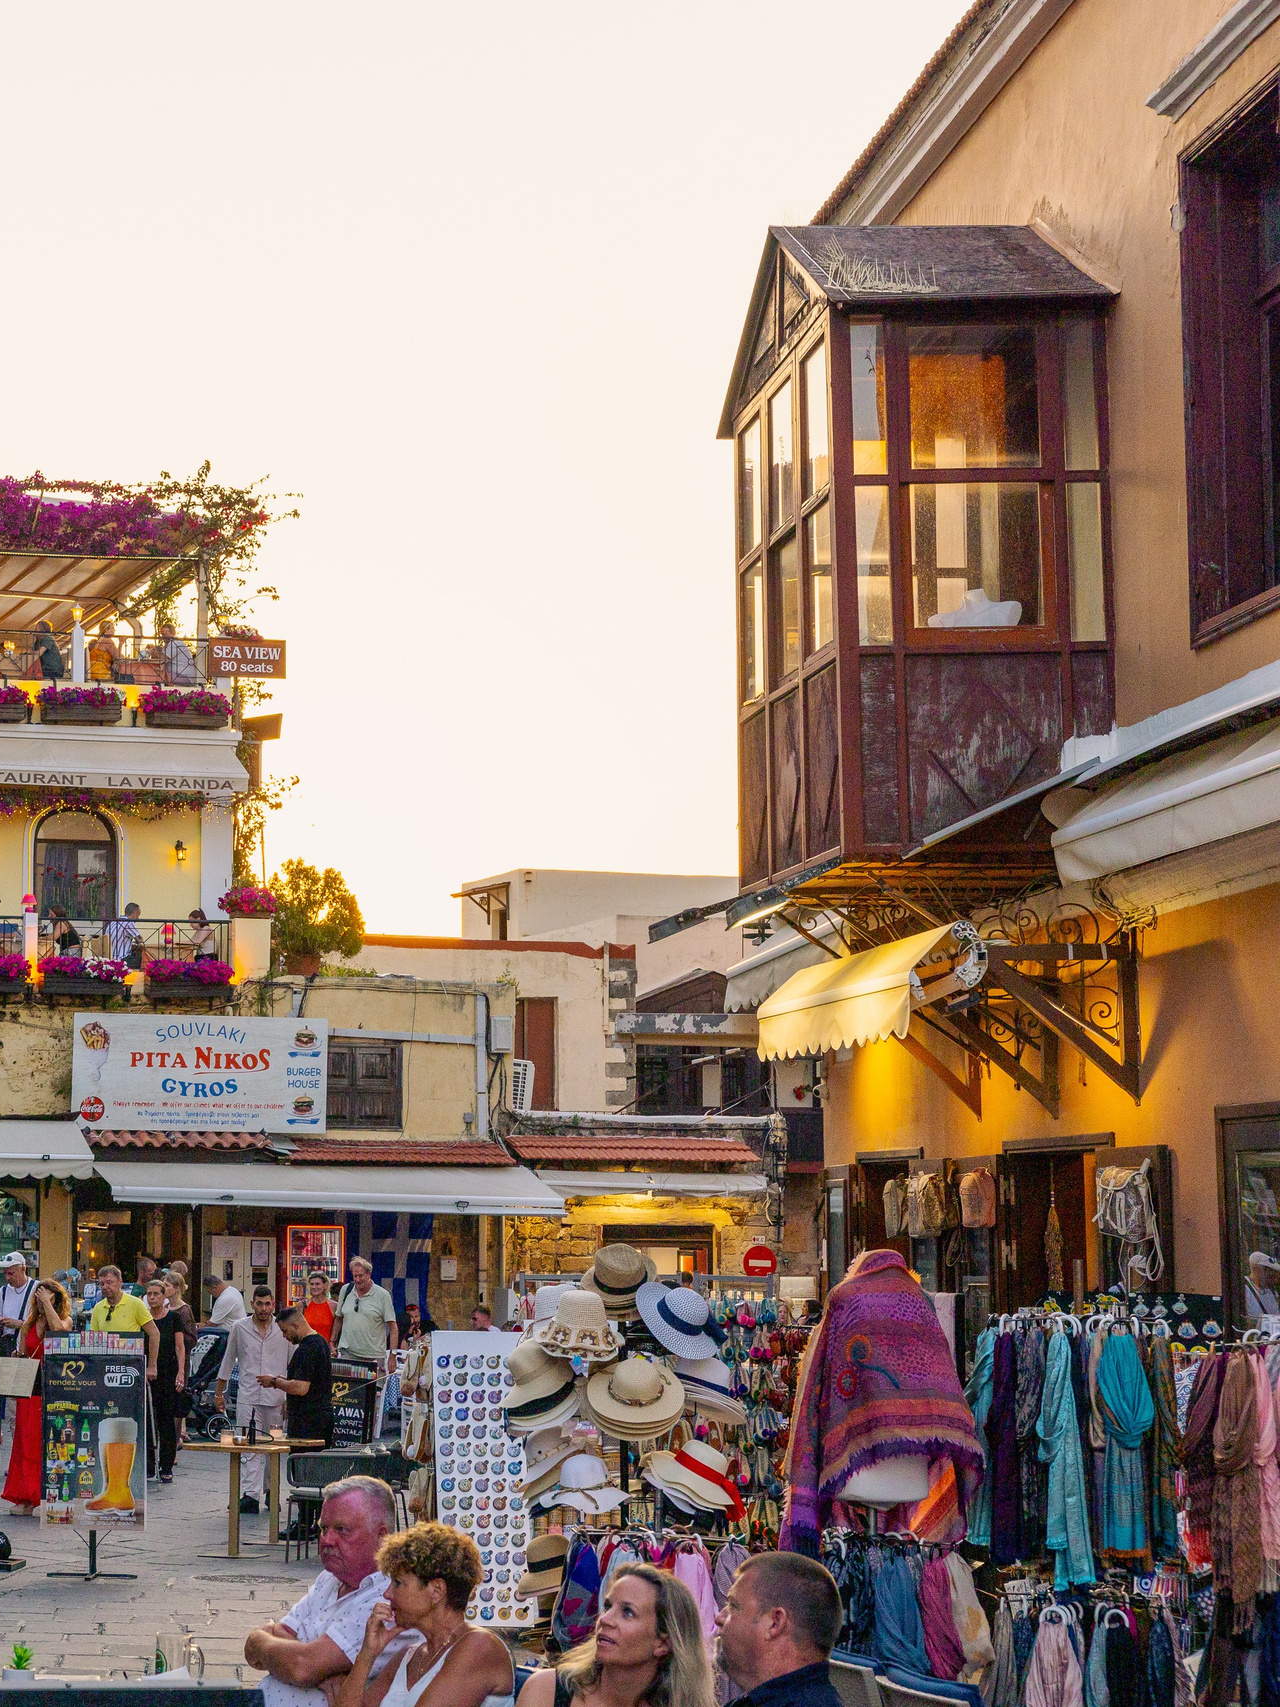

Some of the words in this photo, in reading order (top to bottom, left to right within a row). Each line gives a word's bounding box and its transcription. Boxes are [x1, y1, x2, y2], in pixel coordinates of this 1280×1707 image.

[212, 645, 242, 659] SEA
[244, 646, 281, 660] VIEW
[220, 661, 237, 672] 80
[240, 662, 274, 673] seats
[155, 1022, 247, 1045] SOUVLAKI
[130, 1051, 188, 1069] PITA
[286, 1067, 322, 1077] BURGER
[161, 1078, 238, 1098] GYROS
[287, 1079, 320, 1089] HOUSE
[105, 1365, 126, 1373] FREE
[338, 1407, 365, 1419] AWAY
